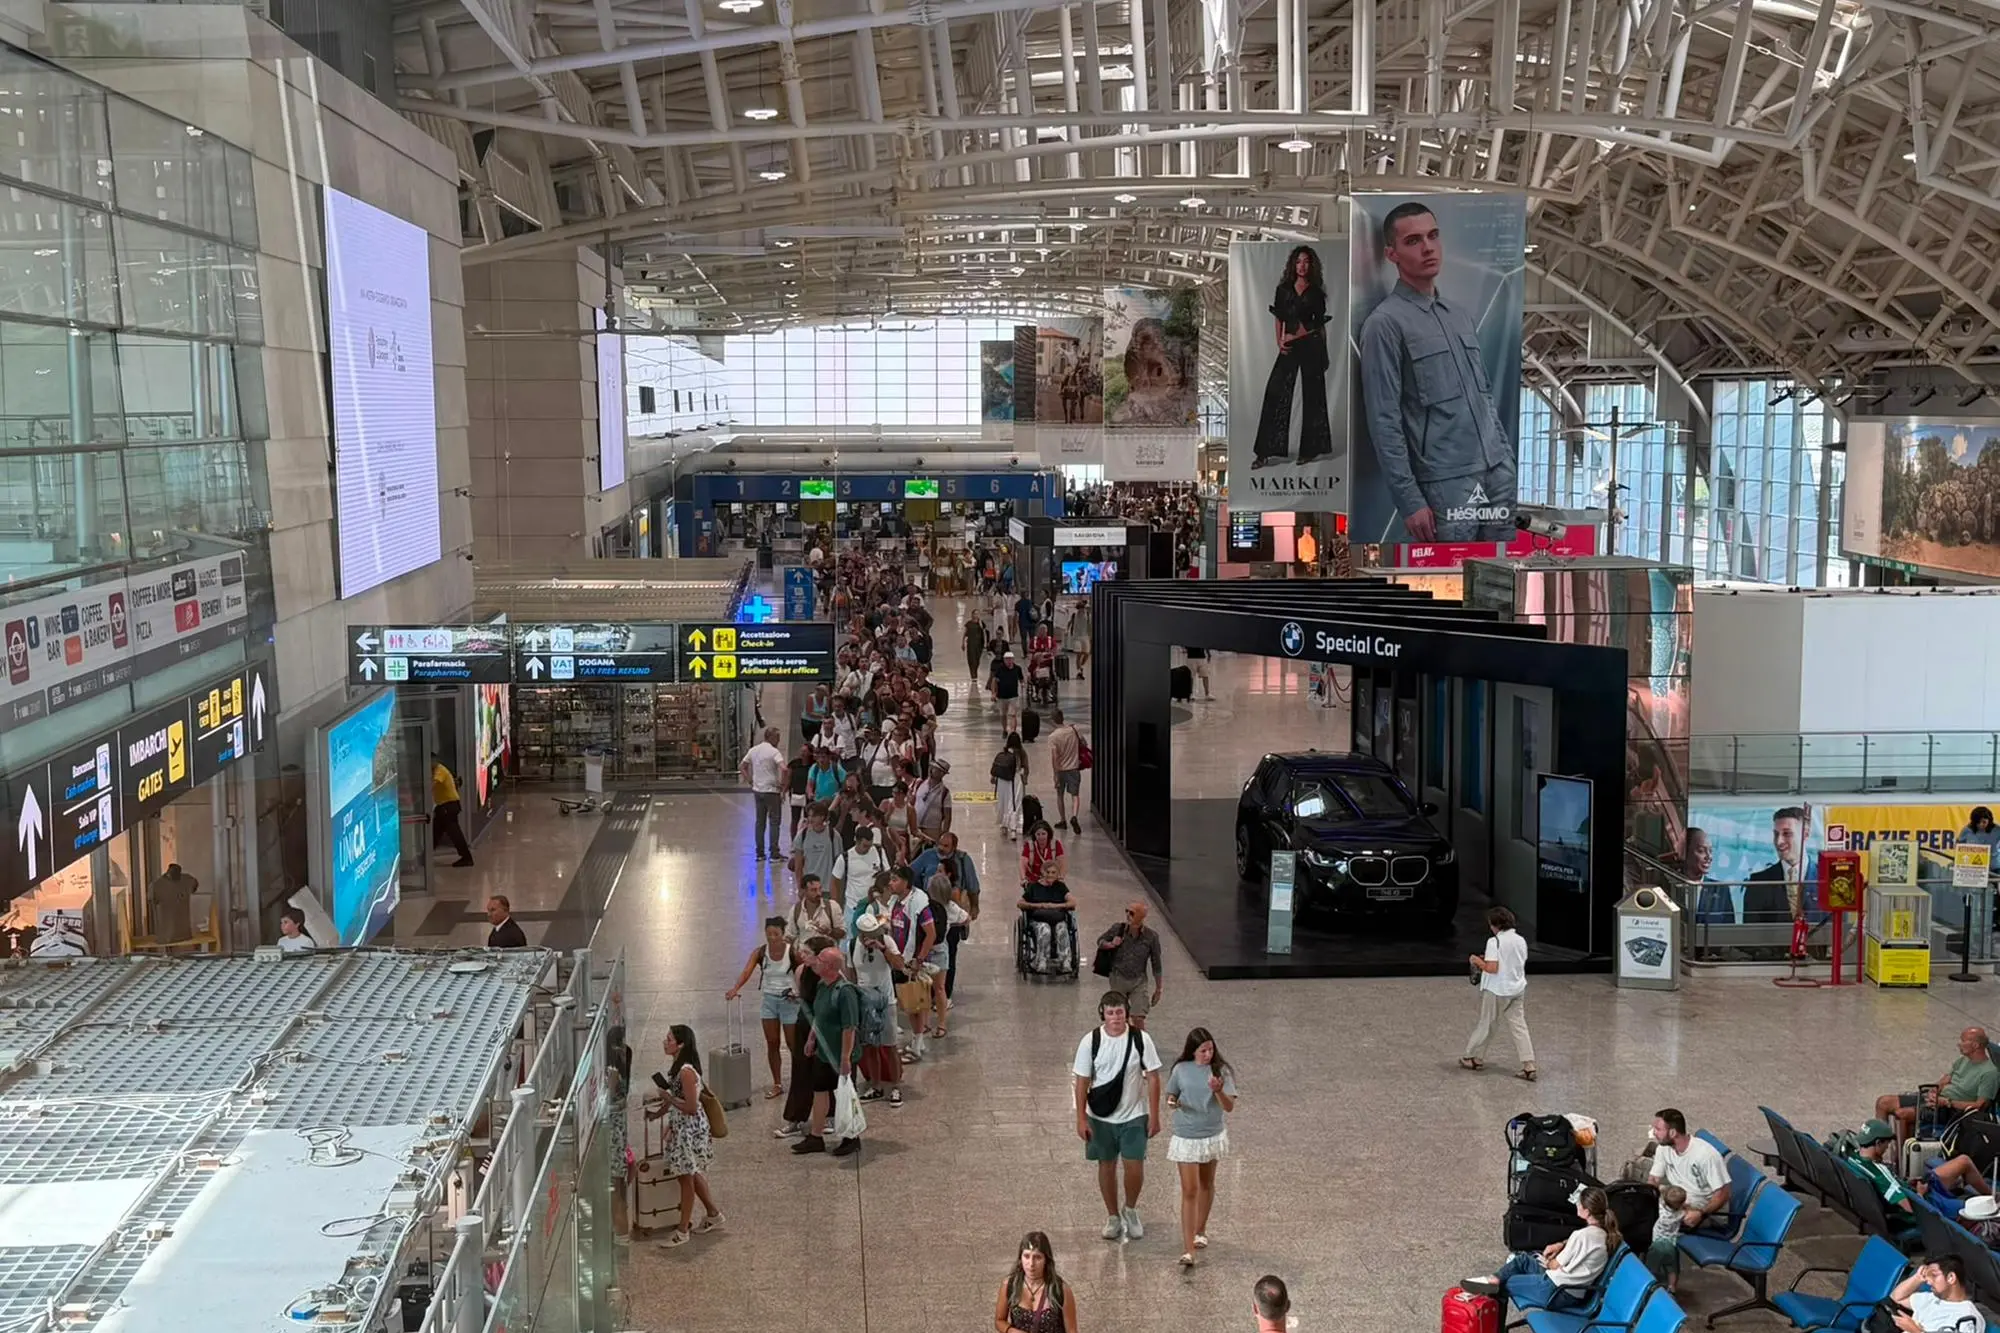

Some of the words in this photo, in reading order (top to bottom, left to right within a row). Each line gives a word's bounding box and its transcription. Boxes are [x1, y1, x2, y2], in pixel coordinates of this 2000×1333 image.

[737, 481, 745, 494] 1
[781, 480, 791, 494] 2
[842, 480, 851, 494] 3
[887, 480, 896, 493] 4
[946, 480, 956, 493] 5
[990, 480, 1000, 493] 6
[1030, 480, 1039, 492] A
[1249, 477, 1340, 490] MARKUP
[132, 586, 152, 608] COFFEE
[157, 580, 172, 600] MORE
[81, 603, 102, 626] COFFEE
[44, 615, 61, 635] WINE
[136, 620, 153, 640] PIZZA
[89, 622, 111, 647] BAKERY
[740, 630, 790, 639] Accettazione
[46, 640, 61, 661] BAR
[741, 640, 774, 648] Check-in
[1316, 631, 1371, 654] Special
[1374, 637, 1402, 657] Car
[412, 659, 466, 668] Parafarmacia
[413, 668, 471, 678] Parapharmacy
[579, 667, 597, 675] TAX
[599, 667, 617, 675] FREE
[618, 667, 650, 675] REFUND
[740, 667, 766, 675] Airline
[768, 667, 792, 675] ticket
[793, 667, 818, 675] offices
[129, 728, 168, 767] IMBARCHI
[138, 769, 163, 802] GATES
[339, 820, 366, 872] UNICA
[1917, 830, 1955, 850] PER
